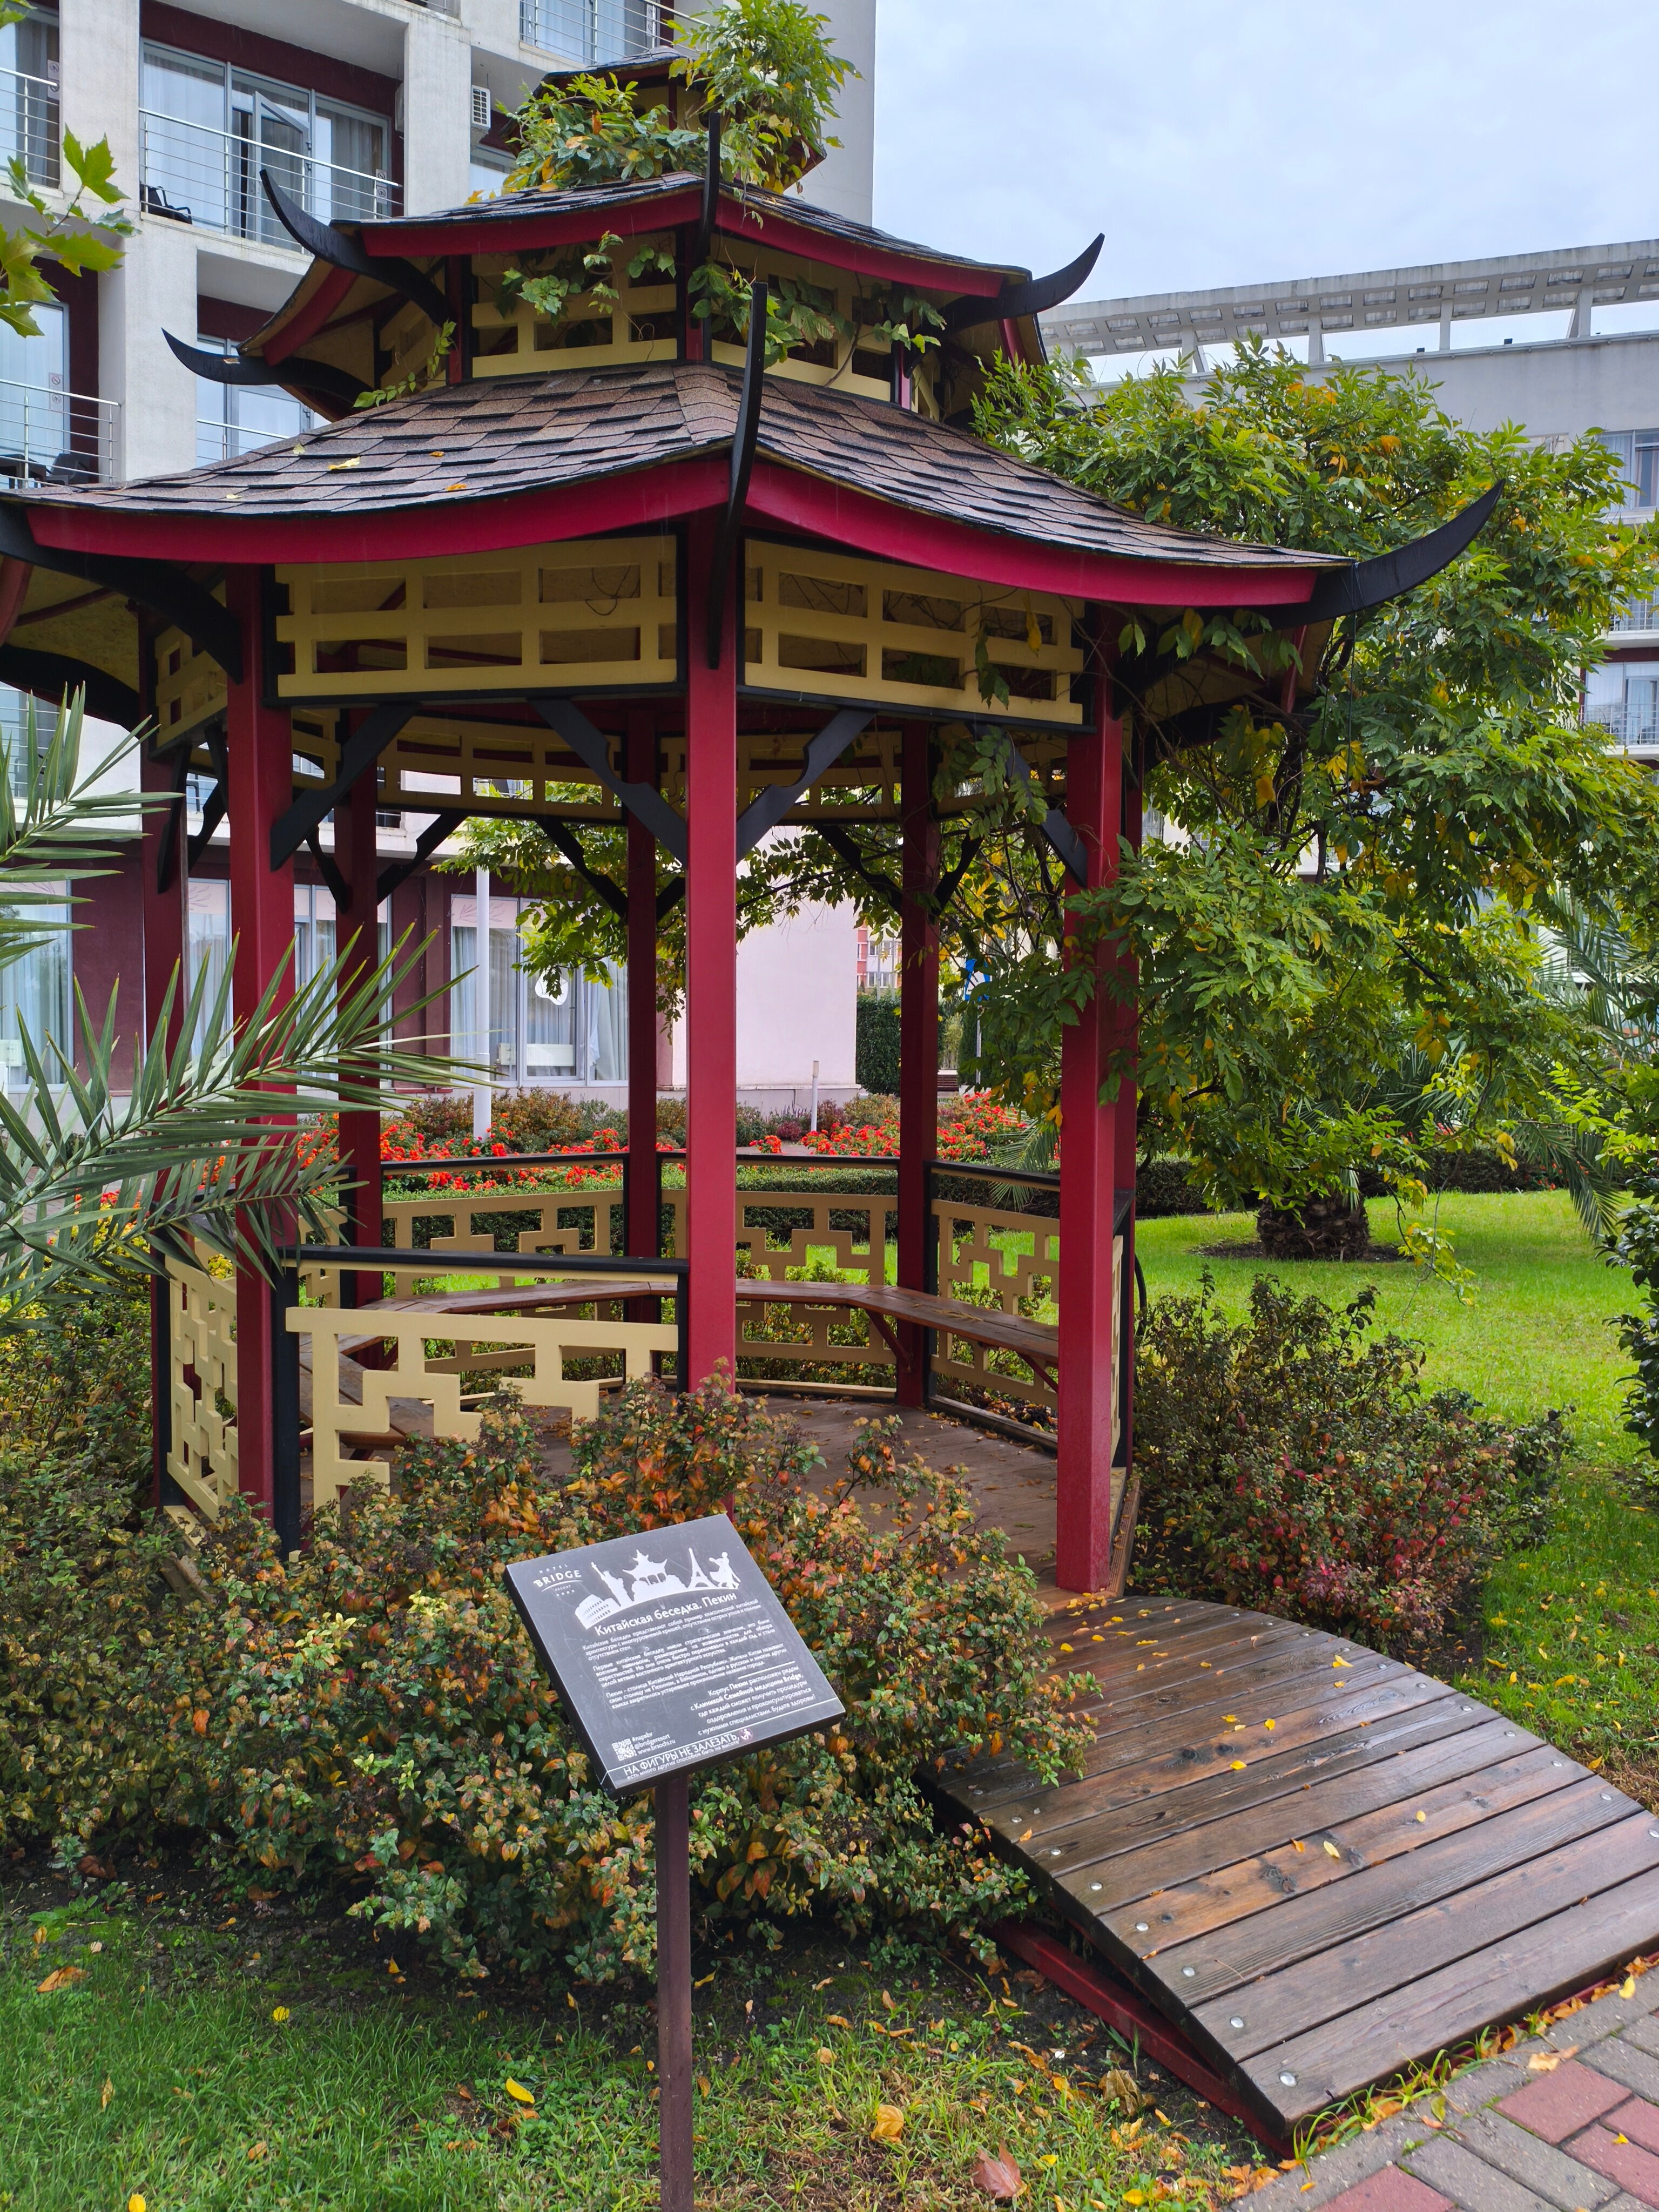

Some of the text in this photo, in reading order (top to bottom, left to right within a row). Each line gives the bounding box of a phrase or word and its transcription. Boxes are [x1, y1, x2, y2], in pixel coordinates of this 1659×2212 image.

[532, 1569, 582, 1587] BRIDGE
[539, 1563, 568, 1574] HOTEL
[582, 1640, 609, 1650] Китайские
[632, 1623, 666, 1637] представляют
[667, 1618, 683, 1627] собой
[684, 1614, 703, 1623] пример
[704, 1604, 735, 1617] классической
[735, 1599, 759, 1608] китайской
[585, 1643, 618, 1656] архитектуры
[621, 1630, 663, 1645] многоуровневой
[662, 1624, 683, 1635] крышей,
[682, 1617, 711, 1628] отсутствием
[744, 1604, 761, 1612] полным
[594, 1592, 737, 1636] Китайская беседка. Пекин
[588, 1649, 619, 1661] отсутствием
[592, 1662, 613, 1671] Первые
[616, 1654, 641, 1665] китайские
[684, 1632, 721, 1645] стратегическое
[723, 1626, 746, 1635] значение,
[596, 1667, 618, 1677] военные
[653, 1647, 687, 1661] размещаемые
[701, 1633, 740, 1647] возвышенностях
[756, 1623, 773, 1631] обзора
[671, 1652, 691, 1661] быстро
[691, 1643, 725, 1655] перекочевали
[729, 1635, 748, 1644] каждый
[601, 1678, 617, 1688] целой
[617, 1674, 636, 1683] ветвью
[635, 1665, 664, 1677] восточного
[664, 1654, 703, 1669] архитектурного
[605, 1690, 623, 1698] Пекин
[626, 1682, 648, 1692] столица
[647, 1674, 674, 1687] Китайской
[673, 1666, 700, 1678] Народной
[728, 1654, 748, 1662] Жители
[761, 1643, 784, 1653] называют
[611, 1701, 629, 1709] языках
[629, 1691, 661, 1704] закрепилось
[660, 1682, 690, 1696] устаревшее
[725, 1665, 747, 1675] названия
[623, 1690, 643, 1700] столицу
[651, 1681, 676, 1691] Пекином,
[707, 1665, 726, 1674] однако
[730, 1659, 750, 1669] русском
[753, 1653, 771, 1661] многих
[771, 1648, 787, 1657] других
[707, 1665, 799, 1696] Корпус Пекин расположен рядом
[693, 1695, 724, 1710] Клиникой
[722, 1687, 754, 1701] Семейной
[754, 1678, 784, 1691] медицины
[782, 1673, 804, 1682] Bridge,
[706, 1707, 747, 1724] оздоровления
[751, 1687, 812, 1710] проконсультироваться
[707, 1702, 731, 1714] каждый
[730, 1697, 751, 1707] сможет
[751, 1690, 777, 1701] получить
[776, 1680, 807, 1694] процедуры
[702, 1722, 729, 1735] нужными
[729, 1709, 772, 1726] специалистами.
[771, 1703, 791, 1713] Будьте
[790, 1693, 816, 1707] здоровы!
[623, 1731, 739, 1776] НА ФИГУРЫ НЕ ЗАЛЕЗАТЬ,
[634, 1734, 670, 1750] @bridgeresort
[637, 1739, 676, 1755] www.brsochi.ru
[639, 1767, 657, 1776] много
[657, 1760, 676, 1771] других
[676, 1752, 702, 1763] способов
